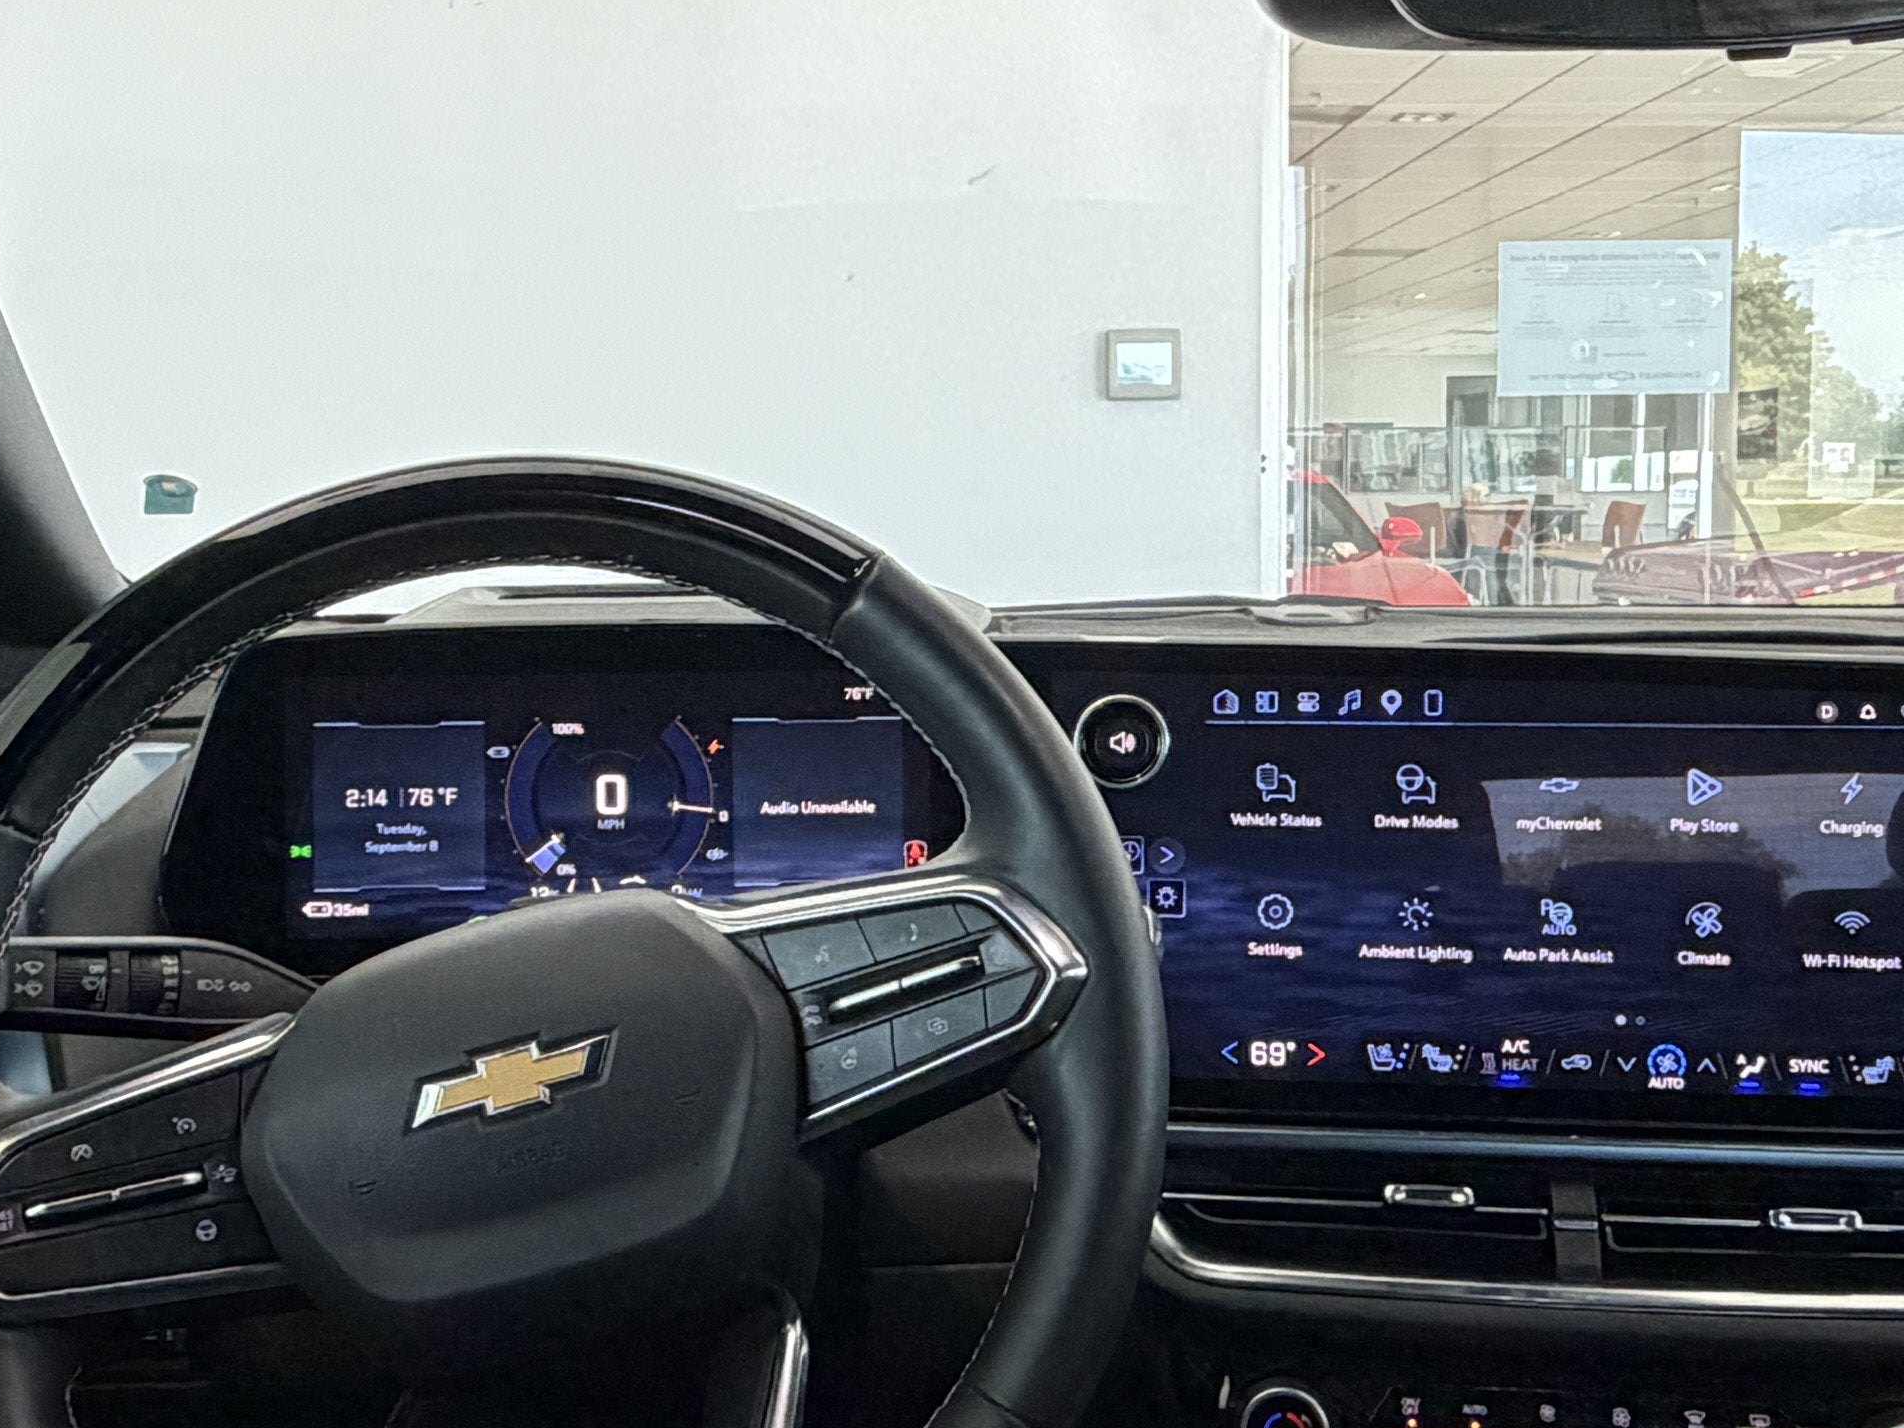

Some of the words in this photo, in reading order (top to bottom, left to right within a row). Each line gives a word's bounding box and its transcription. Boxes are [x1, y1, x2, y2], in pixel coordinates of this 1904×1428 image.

[552, 723, 585, 735] 100%
[345, 788, 389, 808] 2:14
[408, 787, 434, 807] 76
[596, 774, 628, 816] 0
[760, 800, 798, 815] Audio
[801, 799, 876, 815] Unavailable
[597, 819, 625, 830] MPH
[1230, 812, 1278, 827] Vehicle
[1280, 813, 1323, 828] Status
[1374, 814, 1409, 829] Drive
[1412, 815, 1459, 830] Modes
[1516, 817, 1602, 833] myChevrolet
[1670, 818, 1699, 835] Play
[1701, 819, 1739, 833] Store
[376, 823, 427, 836] Tuesday,
[1819, 820, 1884, 837] Charging
[364, 840, 427, 855] September
[1247, 942, 1303, 959] Settings
[1359, 944, 1415, 959] Ambient
[1418, 945, 1474, 963] Lighting
[1504, 948, 1536, 962] Auto
[1539, 949, 1570, 962] Park
[1571, 949, 1614, 963] Assist
[1677, 951, 1731, 966] Climate
[1802, 953, 1840, 969] Wi-Fi
[1843, 954, 1902, 971] Hotspot
[1250, 1041, 1296, 1067] 69°
[1501, 1038, 1531, 1053] A/C
[1788, 1058, 1830, 1074] SYNC
[1501, 1058, 1539, 1071] HEAT
[1648, 1077, 1685, 1090] AUTO
